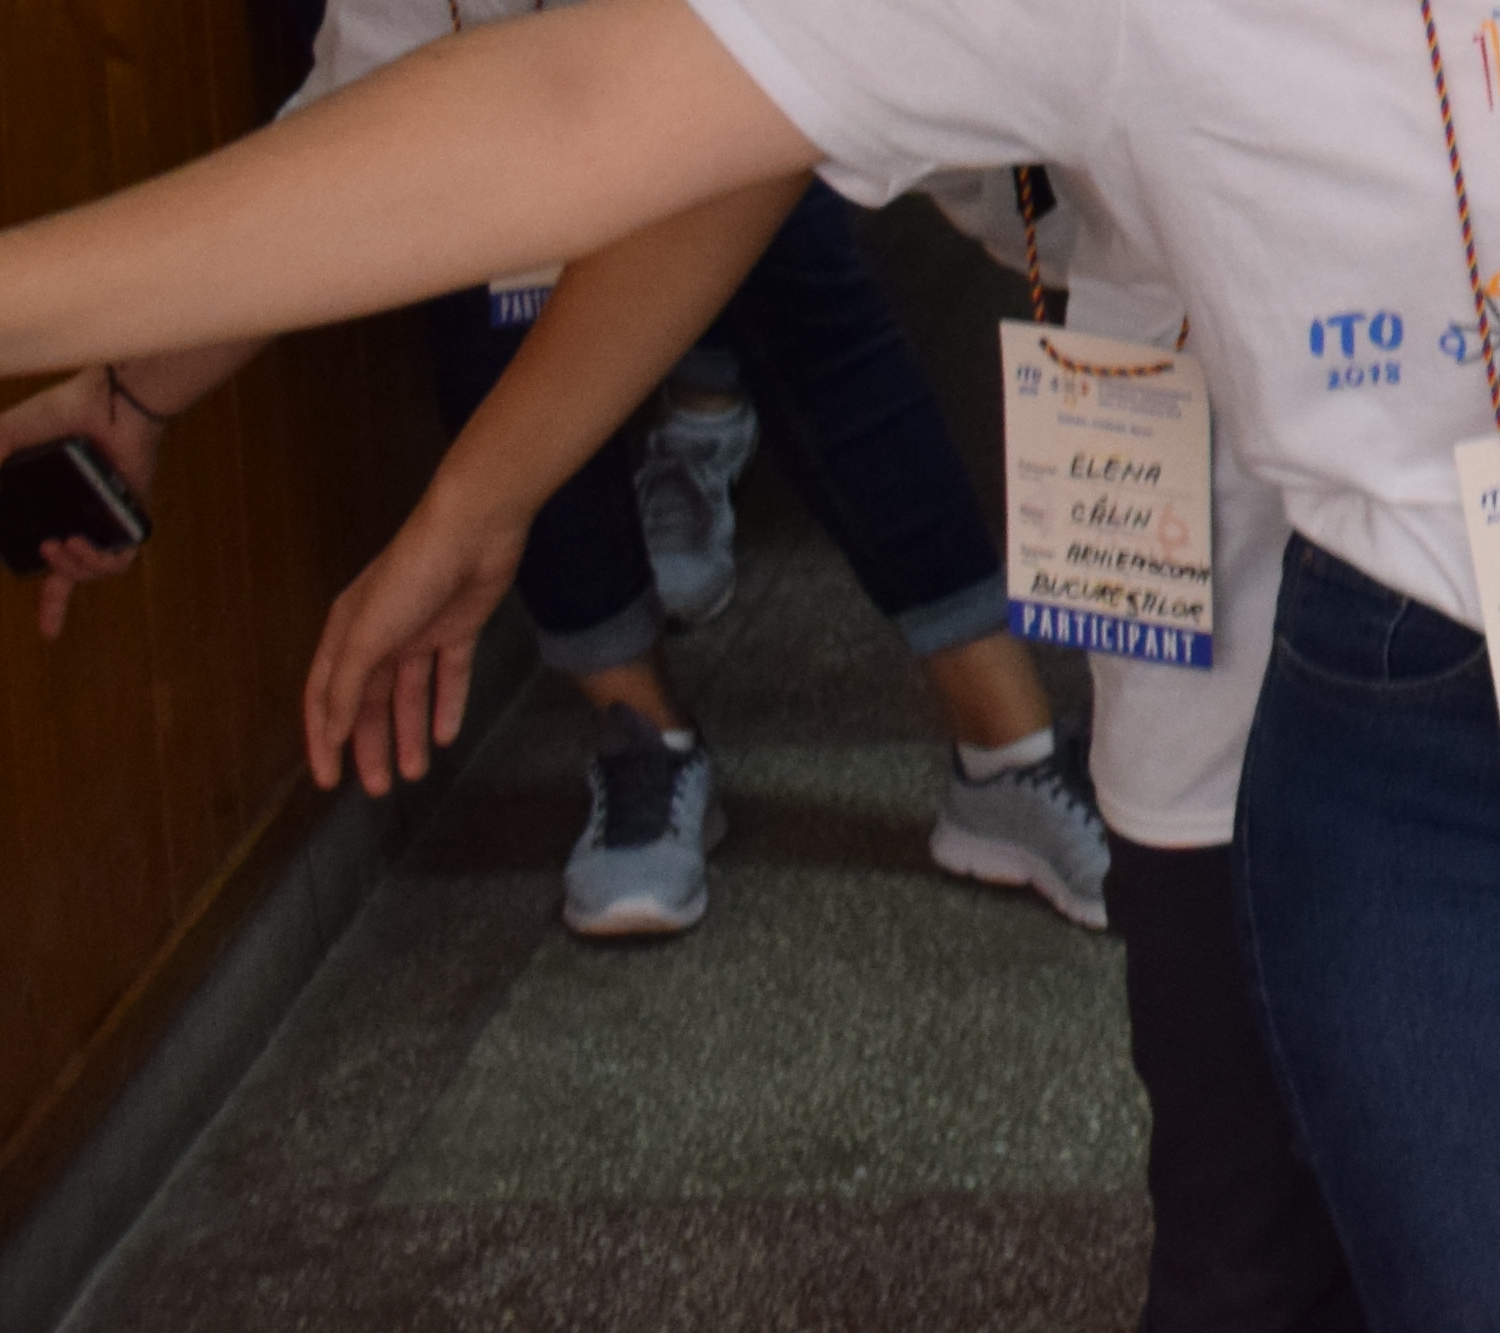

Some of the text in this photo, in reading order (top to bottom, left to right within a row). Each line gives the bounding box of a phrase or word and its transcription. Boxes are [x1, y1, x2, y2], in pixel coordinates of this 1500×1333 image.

[1309, 309, 1404, 359] ITO
[1070, 452, 1161, 483] ELENA
[1024, 604, 1194, 664] PARTICIPANT
